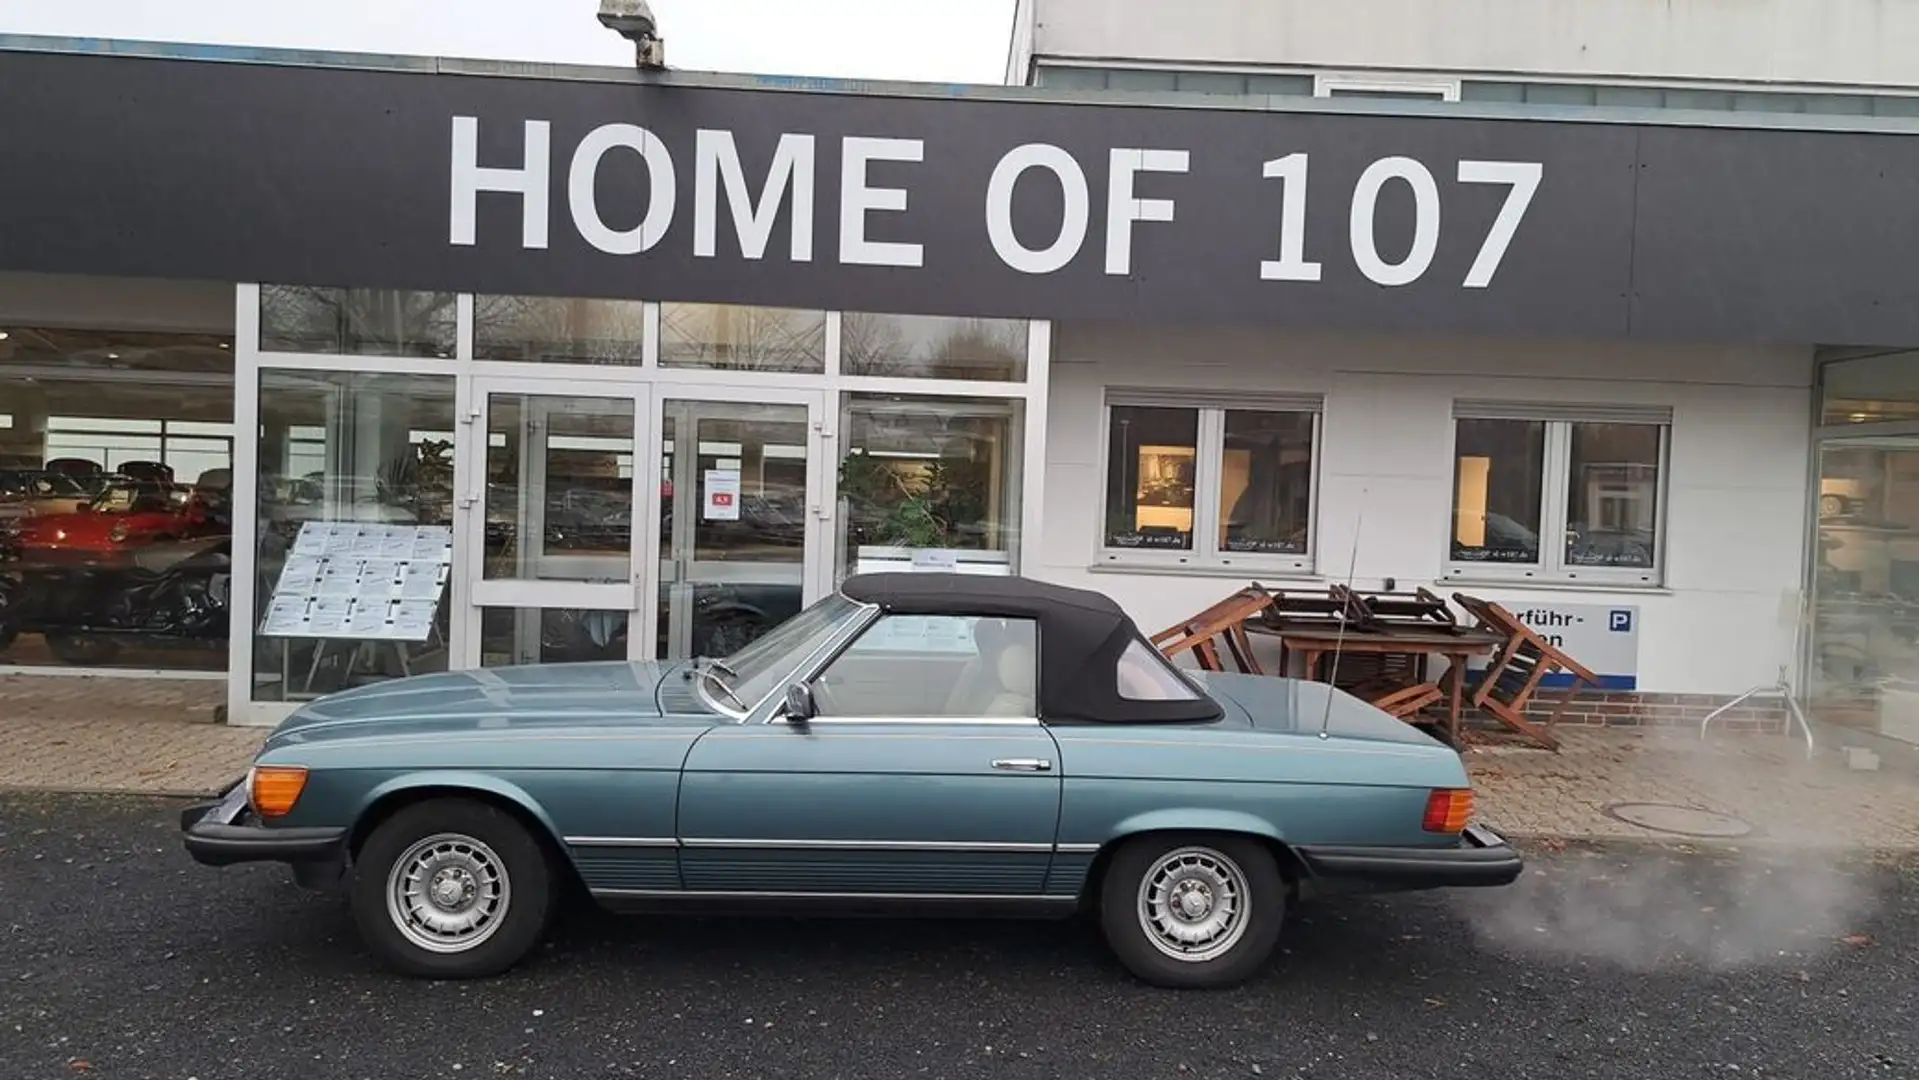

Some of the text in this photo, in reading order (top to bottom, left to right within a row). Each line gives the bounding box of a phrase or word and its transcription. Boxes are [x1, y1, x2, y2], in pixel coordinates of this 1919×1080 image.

[449, 115, 1543, 288] HOME OF 107
[1515, 609, 1584, 627] rführ-
